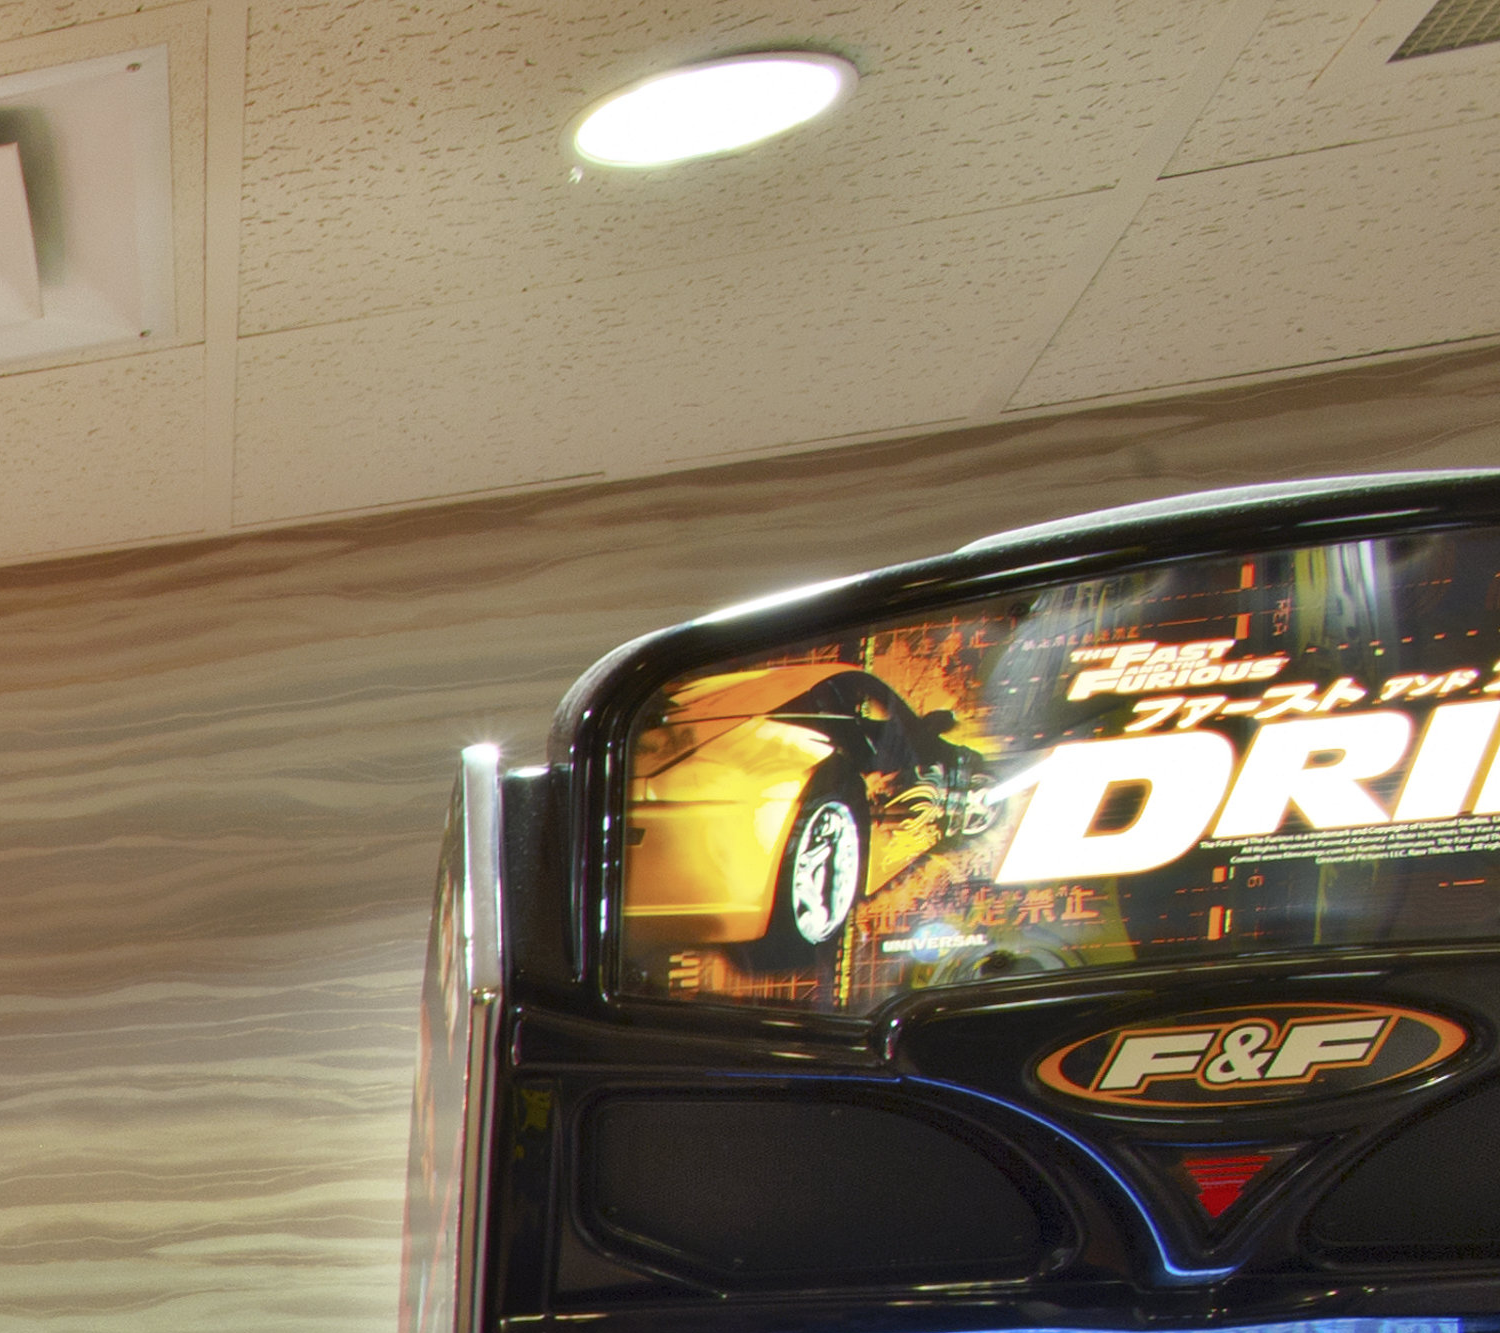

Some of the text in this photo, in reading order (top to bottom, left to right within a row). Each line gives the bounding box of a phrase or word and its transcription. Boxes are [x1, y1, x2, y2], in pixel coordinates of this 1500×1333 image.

[1069, 639, 1237, 671] THE FAST
[1067, 656, 1290, 702] FURIOUS
[1125, 676, 1367, 733] ファースト
[882, 932, 988, 953] UNIVERSAL
[1099, 1017, 1390, 1092] F&F
